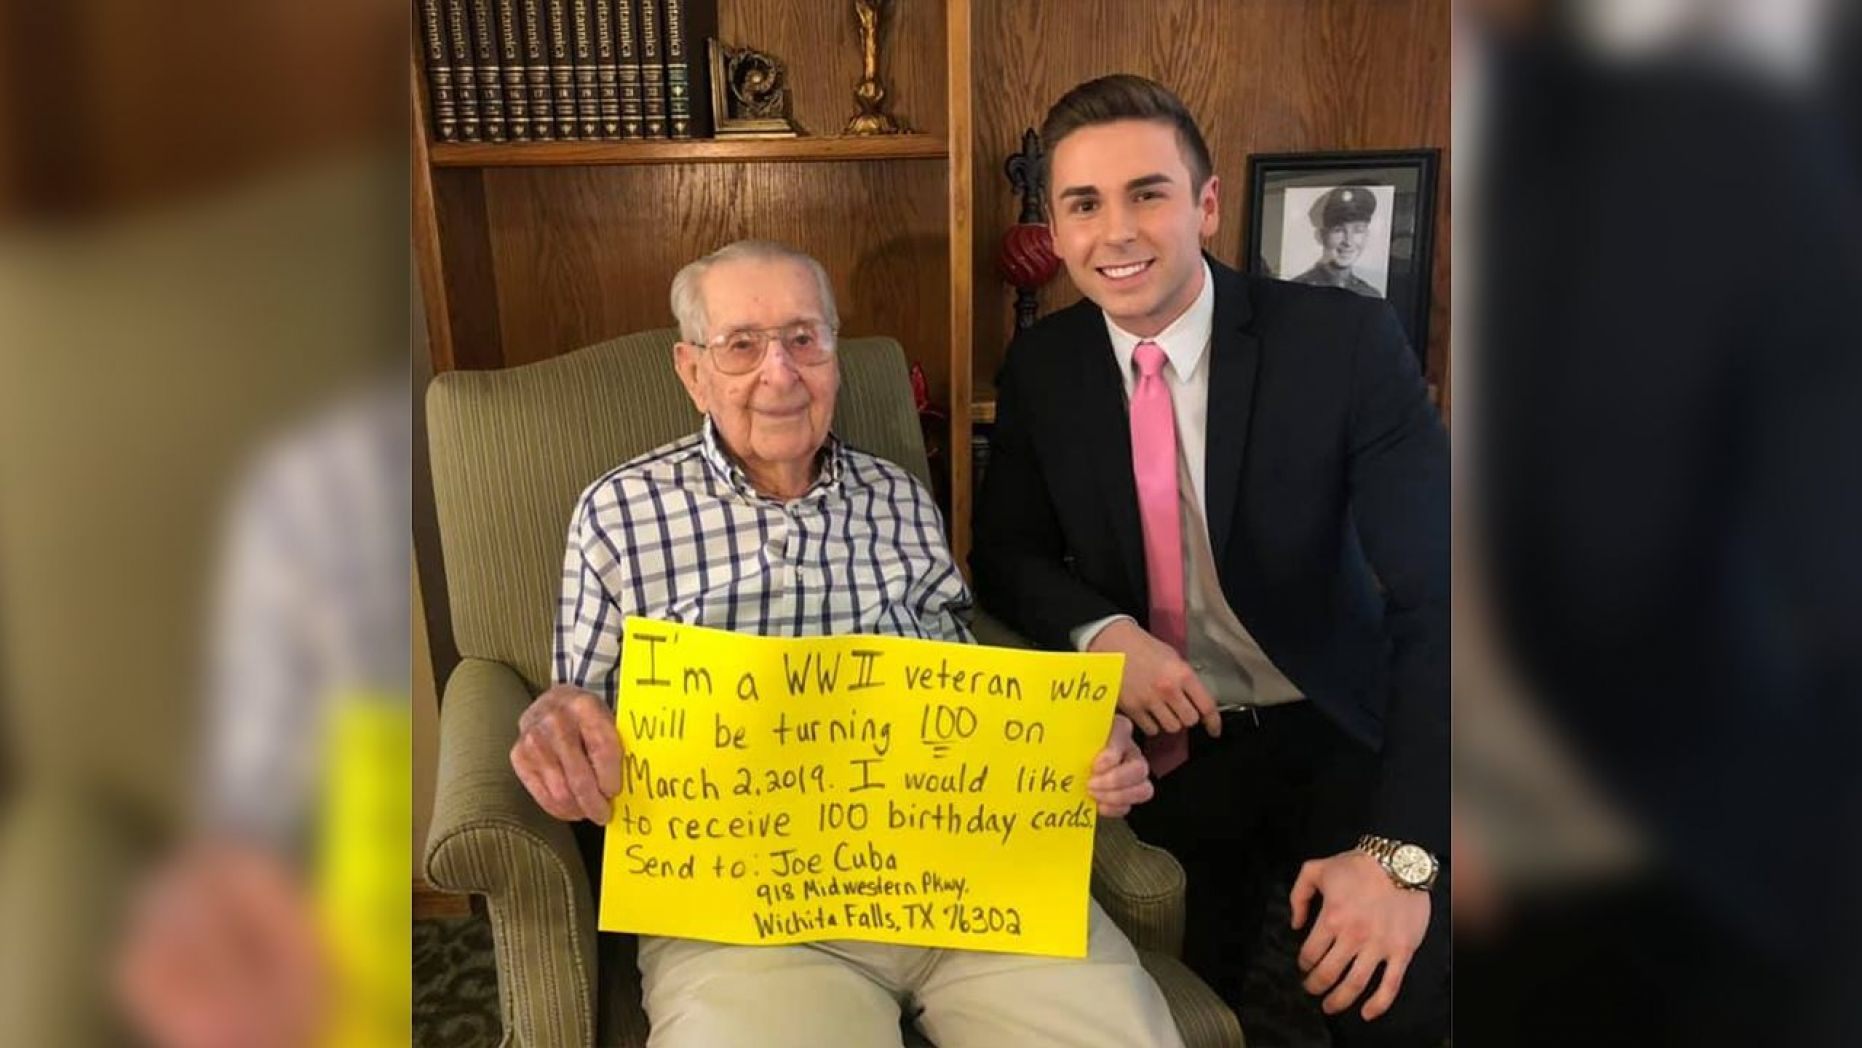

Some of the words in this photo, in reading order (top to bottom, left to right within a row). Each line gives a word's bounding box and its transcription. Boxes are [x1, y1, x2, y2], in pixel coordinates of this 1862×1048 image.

[425, 0, 442, 59] ritannica
[633, 633, 712, 694] I'm
[737, 672, 759, 701] a
[905, 658, 1022, 701] veteran
[1051, 671, 1108, 701] who
[715, 712, 747, 749] be
[773, 709, 891, 756] turning
[921, 703, 978, 740] 100
[1004, 719, 1045, 744] on
[624, 752, 720, 800] March
[849, 758, 885, 792] I
[904, 762, 989, 793] would
[1016, 765, 1074, 793] like
[622, 803, 650, 835] to
[668, 810, 791, 840] receive
[819, 802, 868, 832] 100
[889, 800, 1017, 846] birthday
[1031, 800, 1094, 830] cards.
[625, 843, 694, 879] Send
[769, 848, 822, 877] Joe
[833, 841, 897, 872] Cuba
[757, 882, 794, 906] 918
[803, 876, 917, 900] Midwestern
[922, 871, 969, 901] Pkwy.
[753, 906, 837, 939] Wichita
[844, 902, 902, 932] Falls,
[902, 903, 935, 930] TX
[943, 905, 1021, 936] 76302
